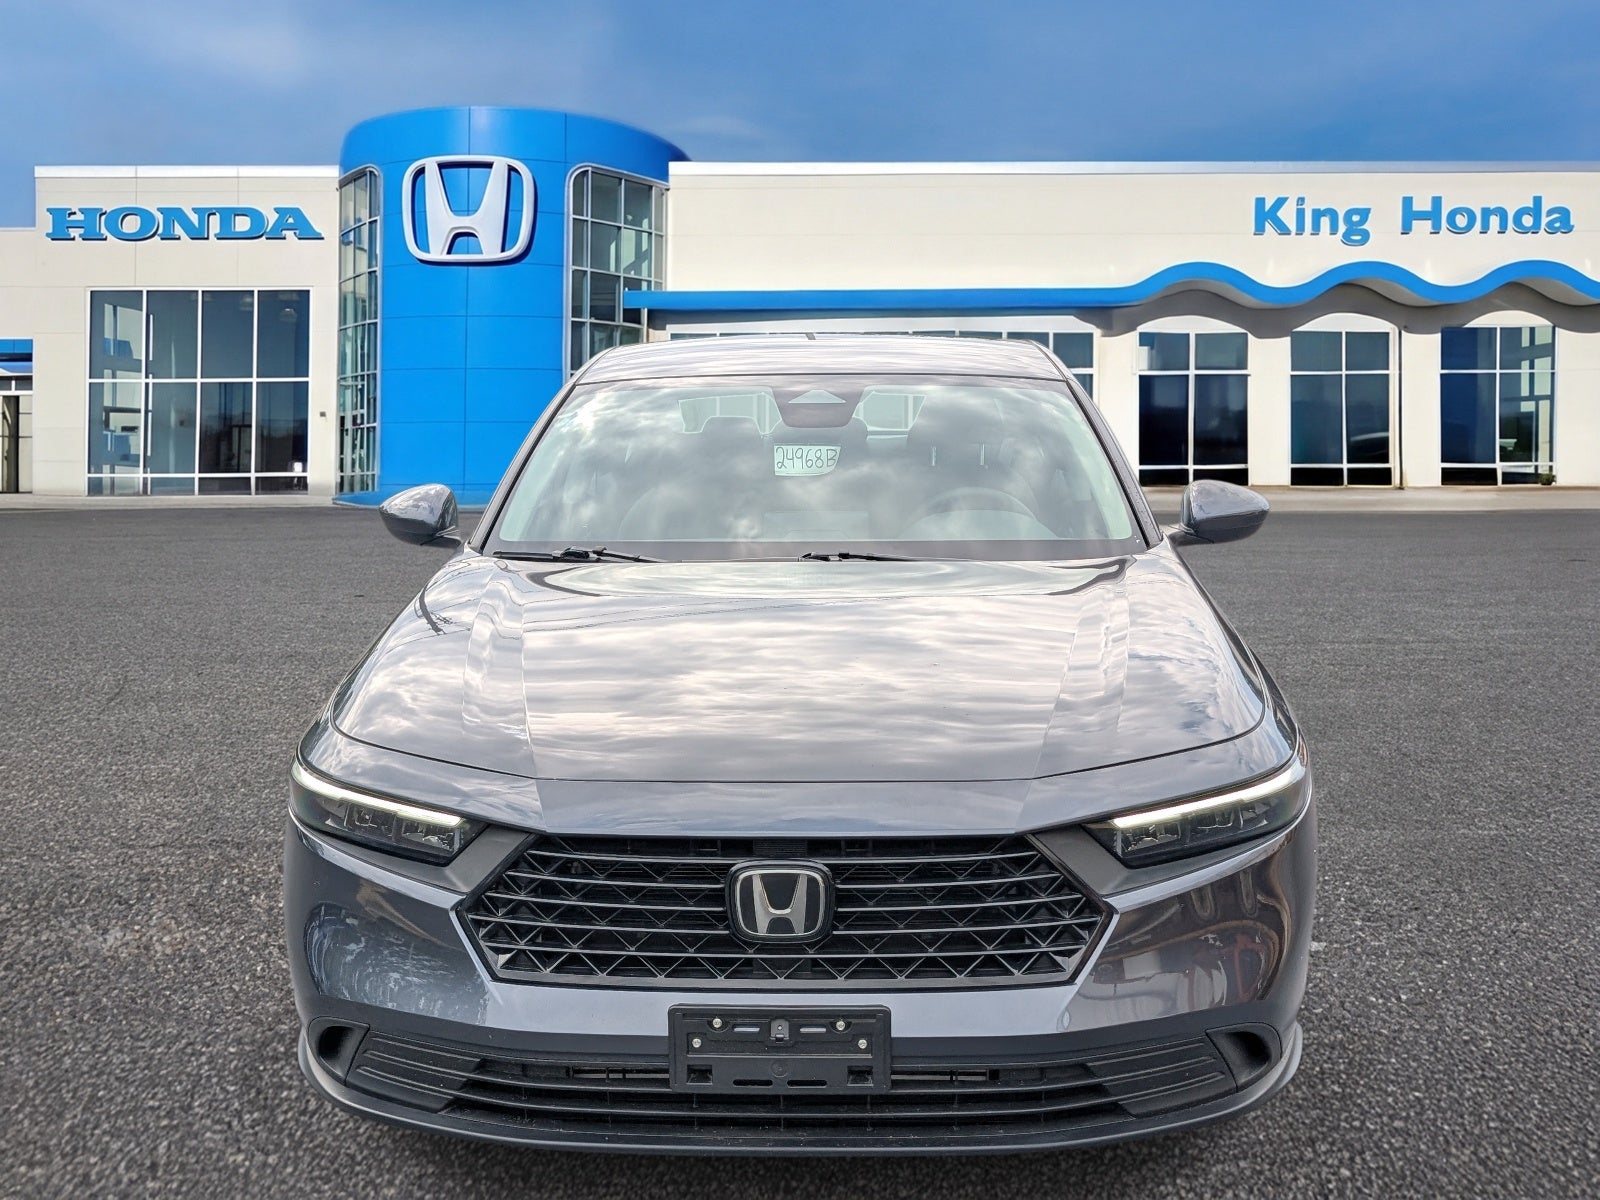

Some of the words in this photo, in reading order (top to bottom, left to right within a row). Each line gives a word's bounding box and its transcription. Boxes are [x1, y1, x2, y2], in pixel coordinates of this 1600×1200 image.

[46, 206, 325, 241] HONDA
[1253, 196, 1372, 246] King
[1400, 195, 1575, 234] Honda
[775, 446, 838, 469] 24968B
